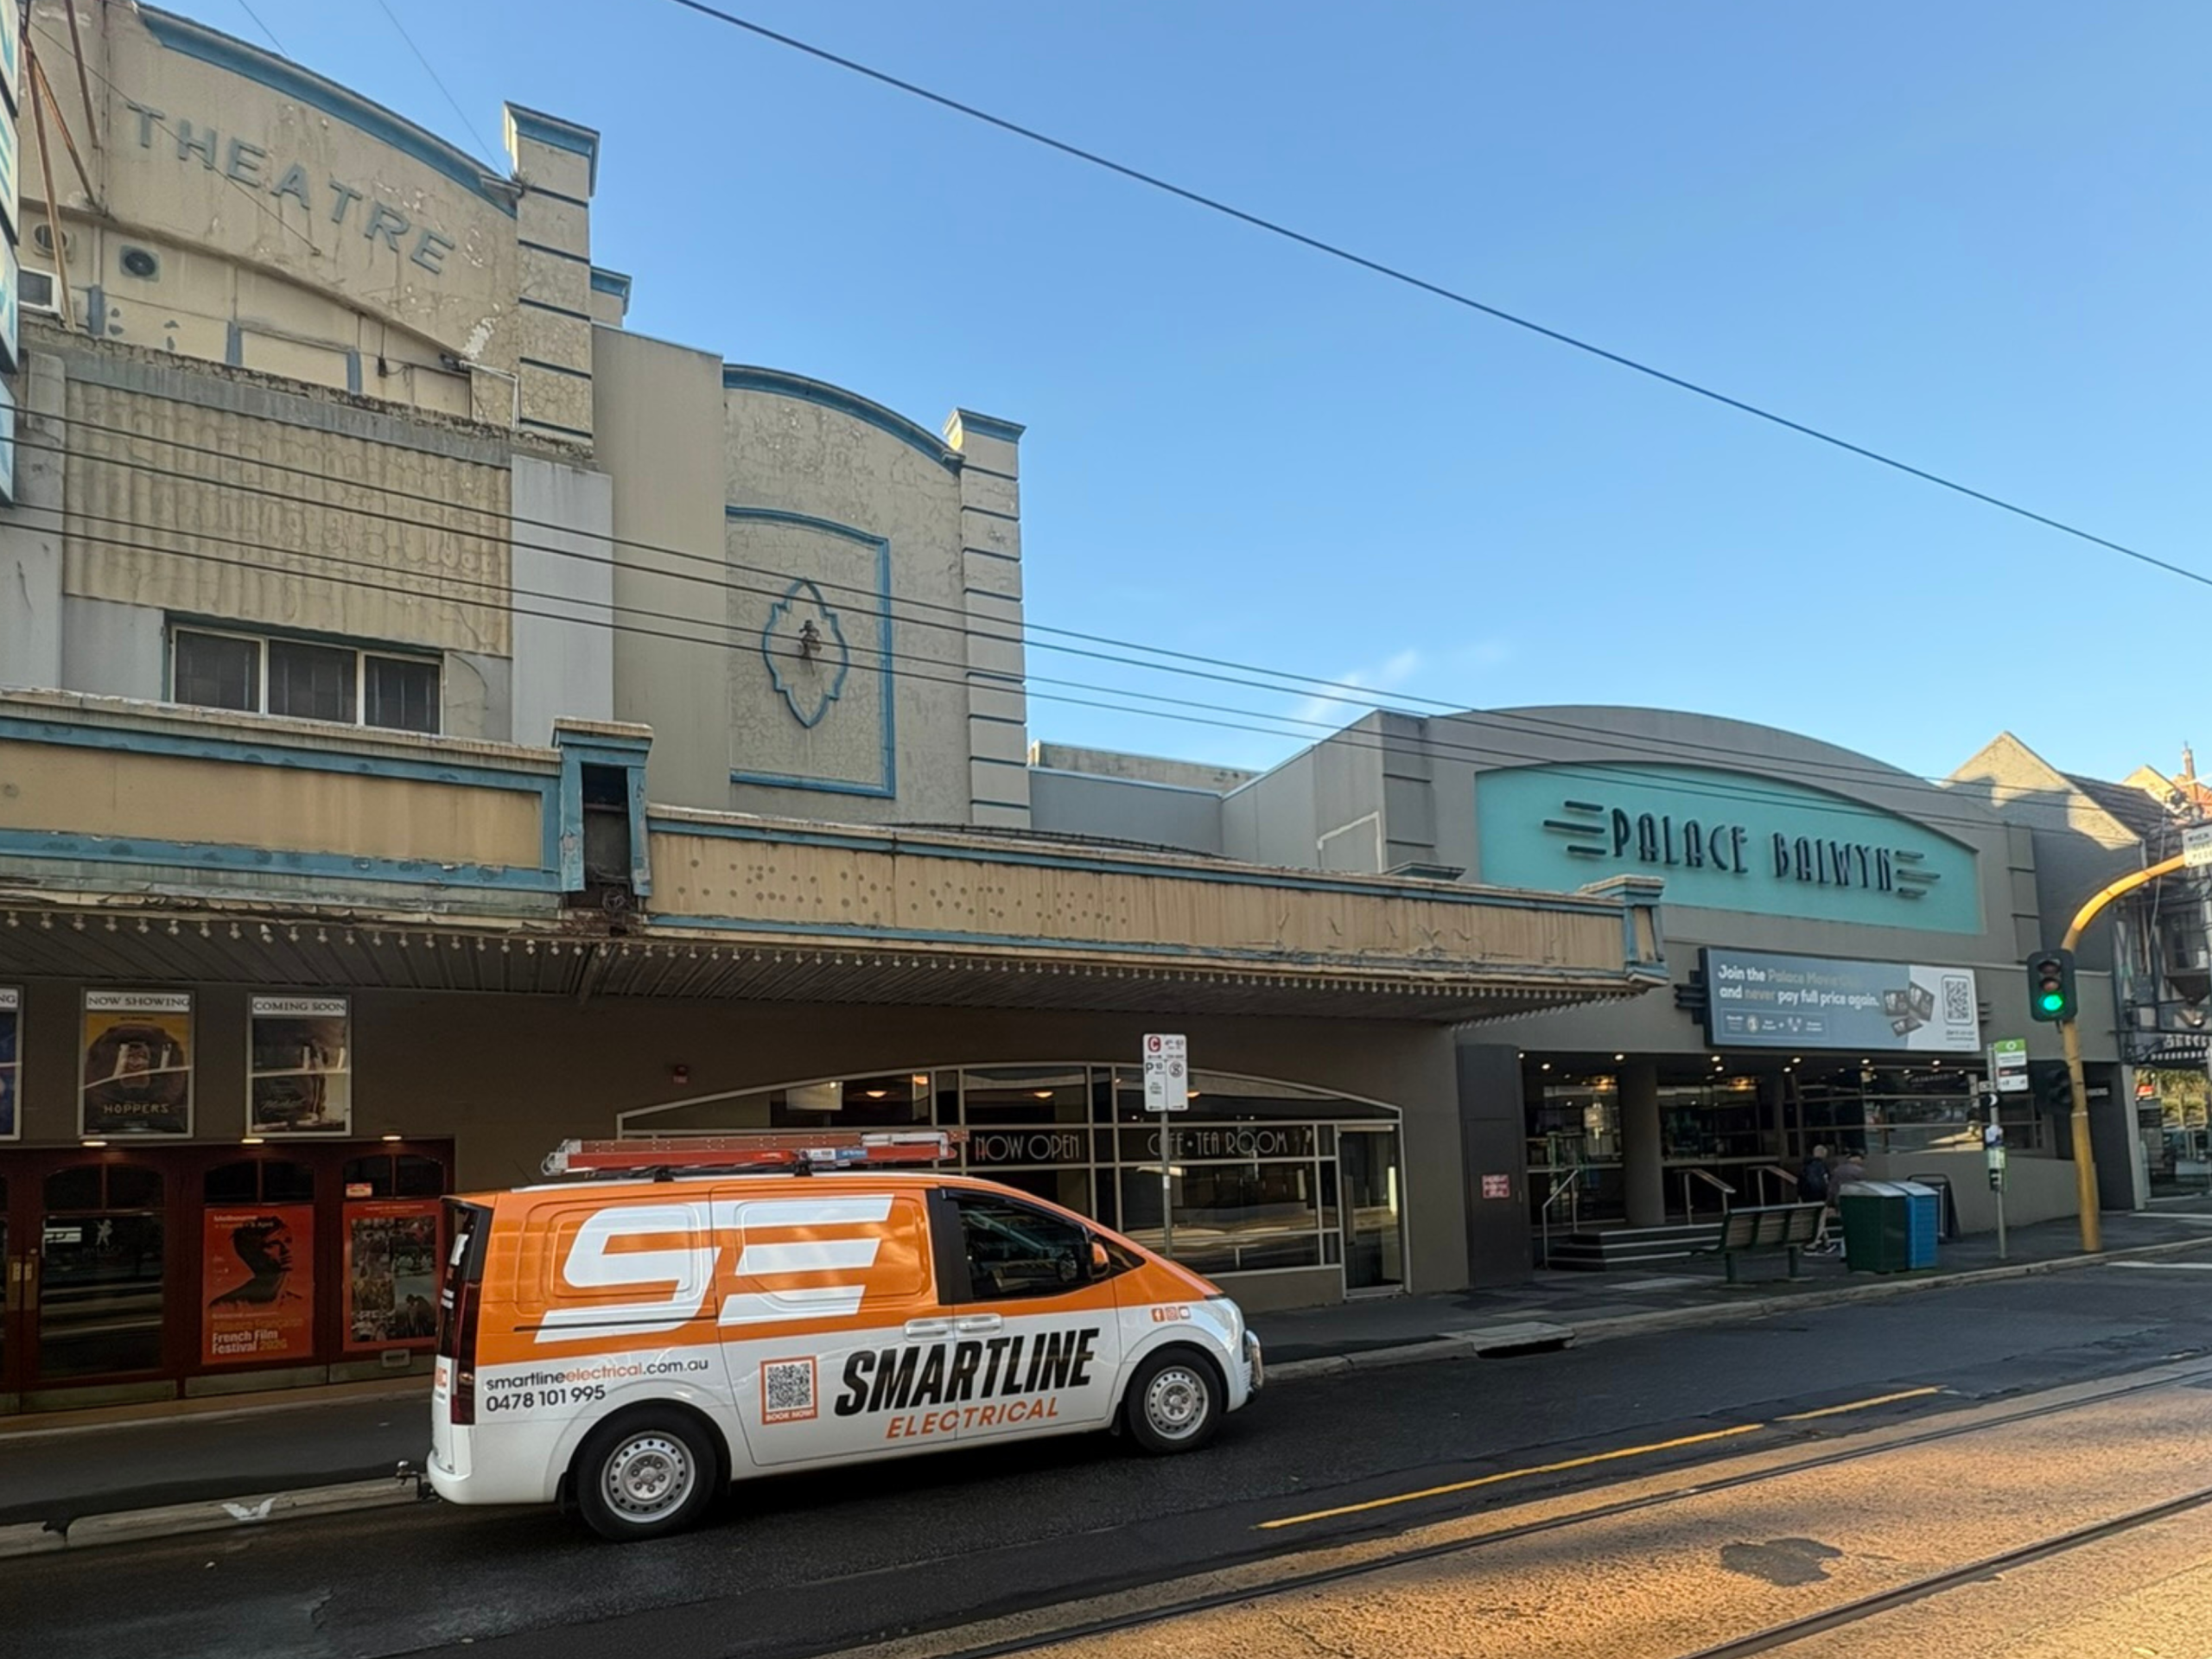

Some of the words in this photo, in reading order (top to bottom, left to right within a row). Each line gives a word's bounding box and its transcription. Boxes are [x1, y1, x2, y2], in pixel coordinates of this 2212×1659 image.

[126, 104, 454, 274] THEATRE
[1611, 806, 1749, 874] PALACE
[1771, 831, 1894, 893] BALWYN
[1718, 965, 1745, 981] Join
[1747, 968, 1766, 982] the
[87, 996, 122, 1007] NOW
[125, 996, 190, 1008] SHOWING
[253, 1001, 308, 1012] COMING
[312, 1002, 346, 1012] SOON
[1719, 985, 1743, 1000] and
[1777, 991, 1799, 1007] pay
[1801, 990, 1819, 1005] full
[1820, 992, 1847, 1007] price
[103, 1103, 170, 1115] HOPPERS
[975, 1135, 1024, 1161] NOW
[1028, 1134, 1079, 1160] OPEN
[1147, 1132, 1184, 1156] CFE
[1196, 1132, 1220, 1154] TEA
[1225, 1129, 1288, 1155] ROOM
[213, 1331, 252, 1343] French
[254, 1329, 278, 1341] Film
[213, 1341, 257, 1354] Festival
[485, 1357, 709, 1391] smartlineelectrical.com.au
[833, 1327, 1100, 1418] SMARTLINE
[486, 1392, 535, 1413] 0478
[537, 1389, 568, 1407] 101
[570, 1384, 606, 1402] 995
[766, 1412, 791, 1422] BOOK
[885, 1396, 1059, 1440] ELECTRICAL
